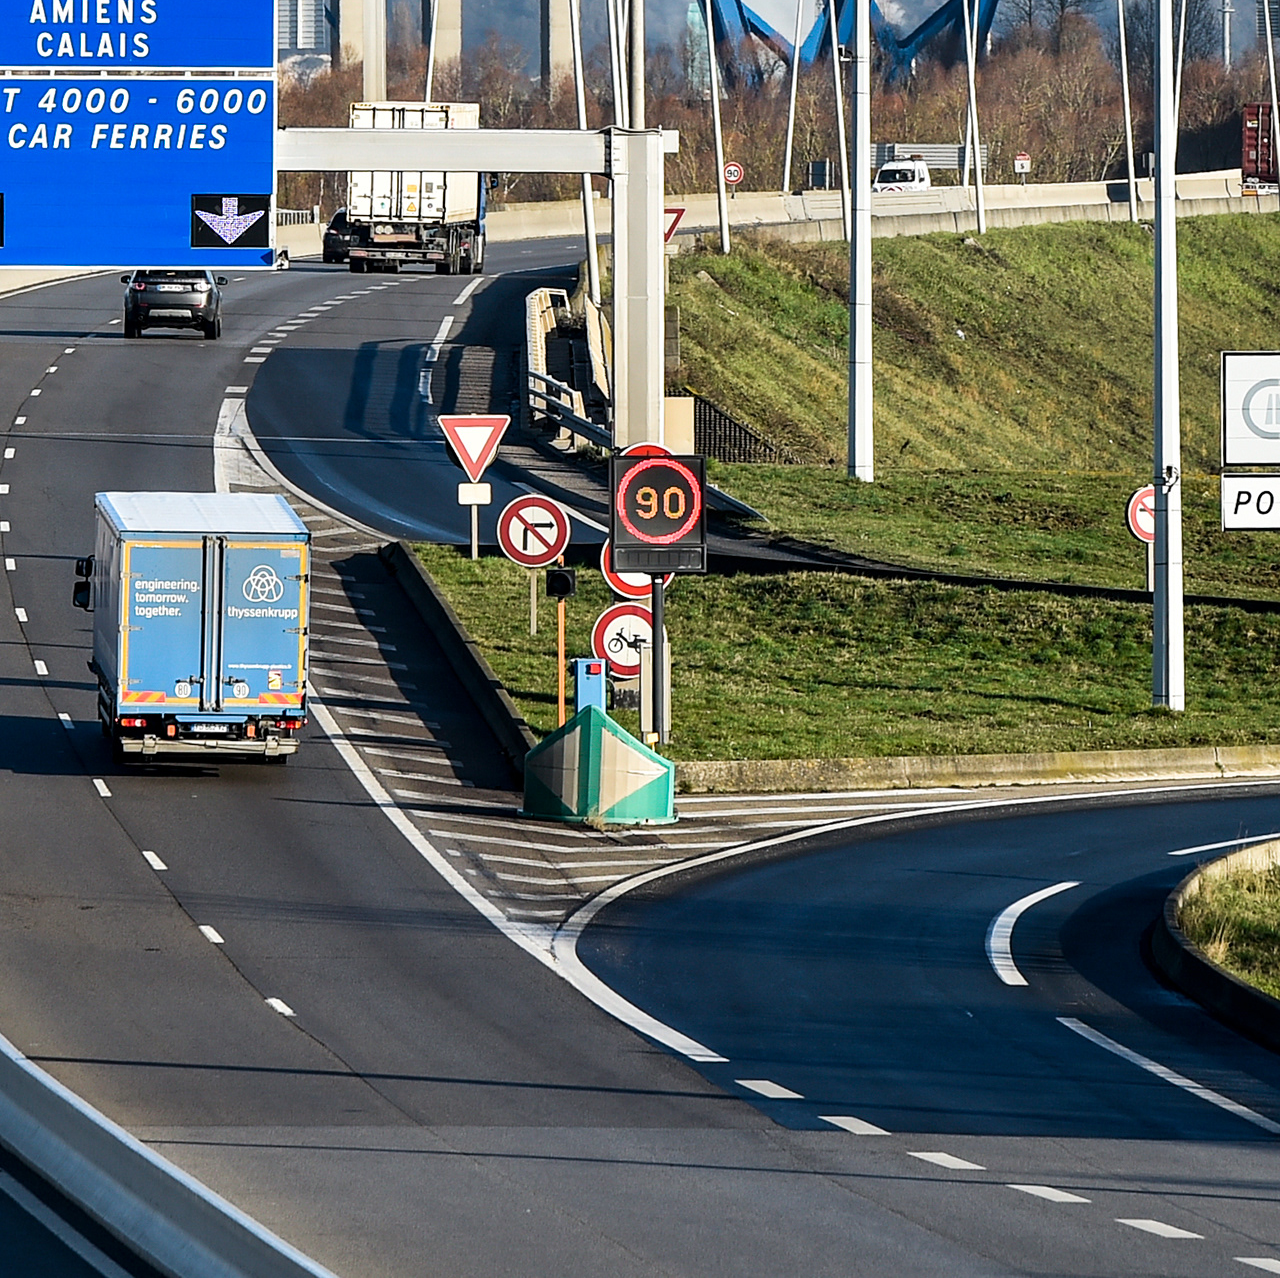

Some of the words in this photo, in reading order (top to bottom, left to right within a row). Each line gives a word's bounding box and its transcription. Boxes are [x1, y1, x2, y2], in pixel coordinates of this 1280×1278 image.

[30, 0, 157, 23] AMIENS
[37, 32, 149, 57] CALAIS
[38, 88, 129, 113] 4000
[176, 88, 266, 113] 6000
[8, 124, 72, 149] CAR
[91, 124, 228, 149] FERRIES
[726, 170, 738, 178] 90
[635, 486, 686, 519] 90
[135, 578, 200, 592] engineering.
[135, 592, 189, 603] tomorrow.
[135, 605, 182, 618] together.
[227, 606, 299, 620] thyssenkrupp
[177, 684, 188, 695] 80
[236, 684, 246, 696] 90
